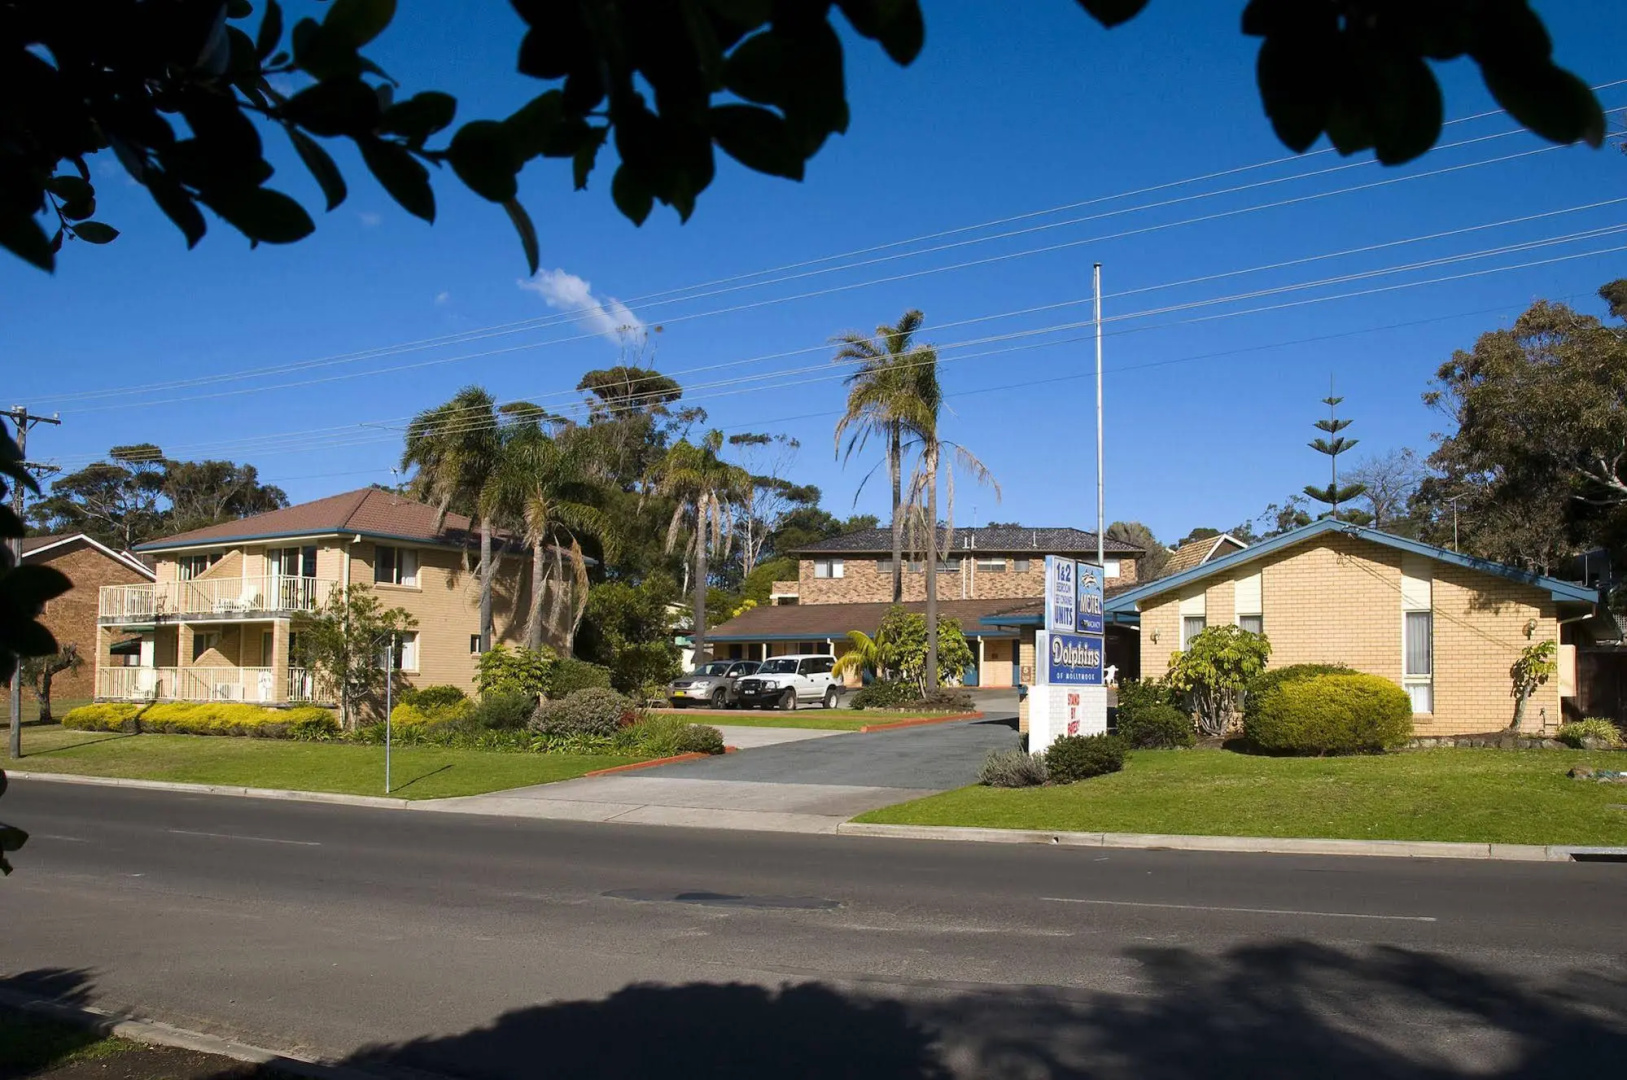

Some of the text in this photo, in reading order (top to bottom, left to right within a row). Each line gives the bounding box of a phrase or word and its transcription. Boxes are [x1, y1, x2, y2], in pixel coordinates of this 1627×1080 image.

[1080, 593, 1101, 615] MOTEL
[1055, 605, 1073, 626] UNITS
[1052, 637, 1100, 667] Dolphins
[1056, 672, 1063, 680] OF
